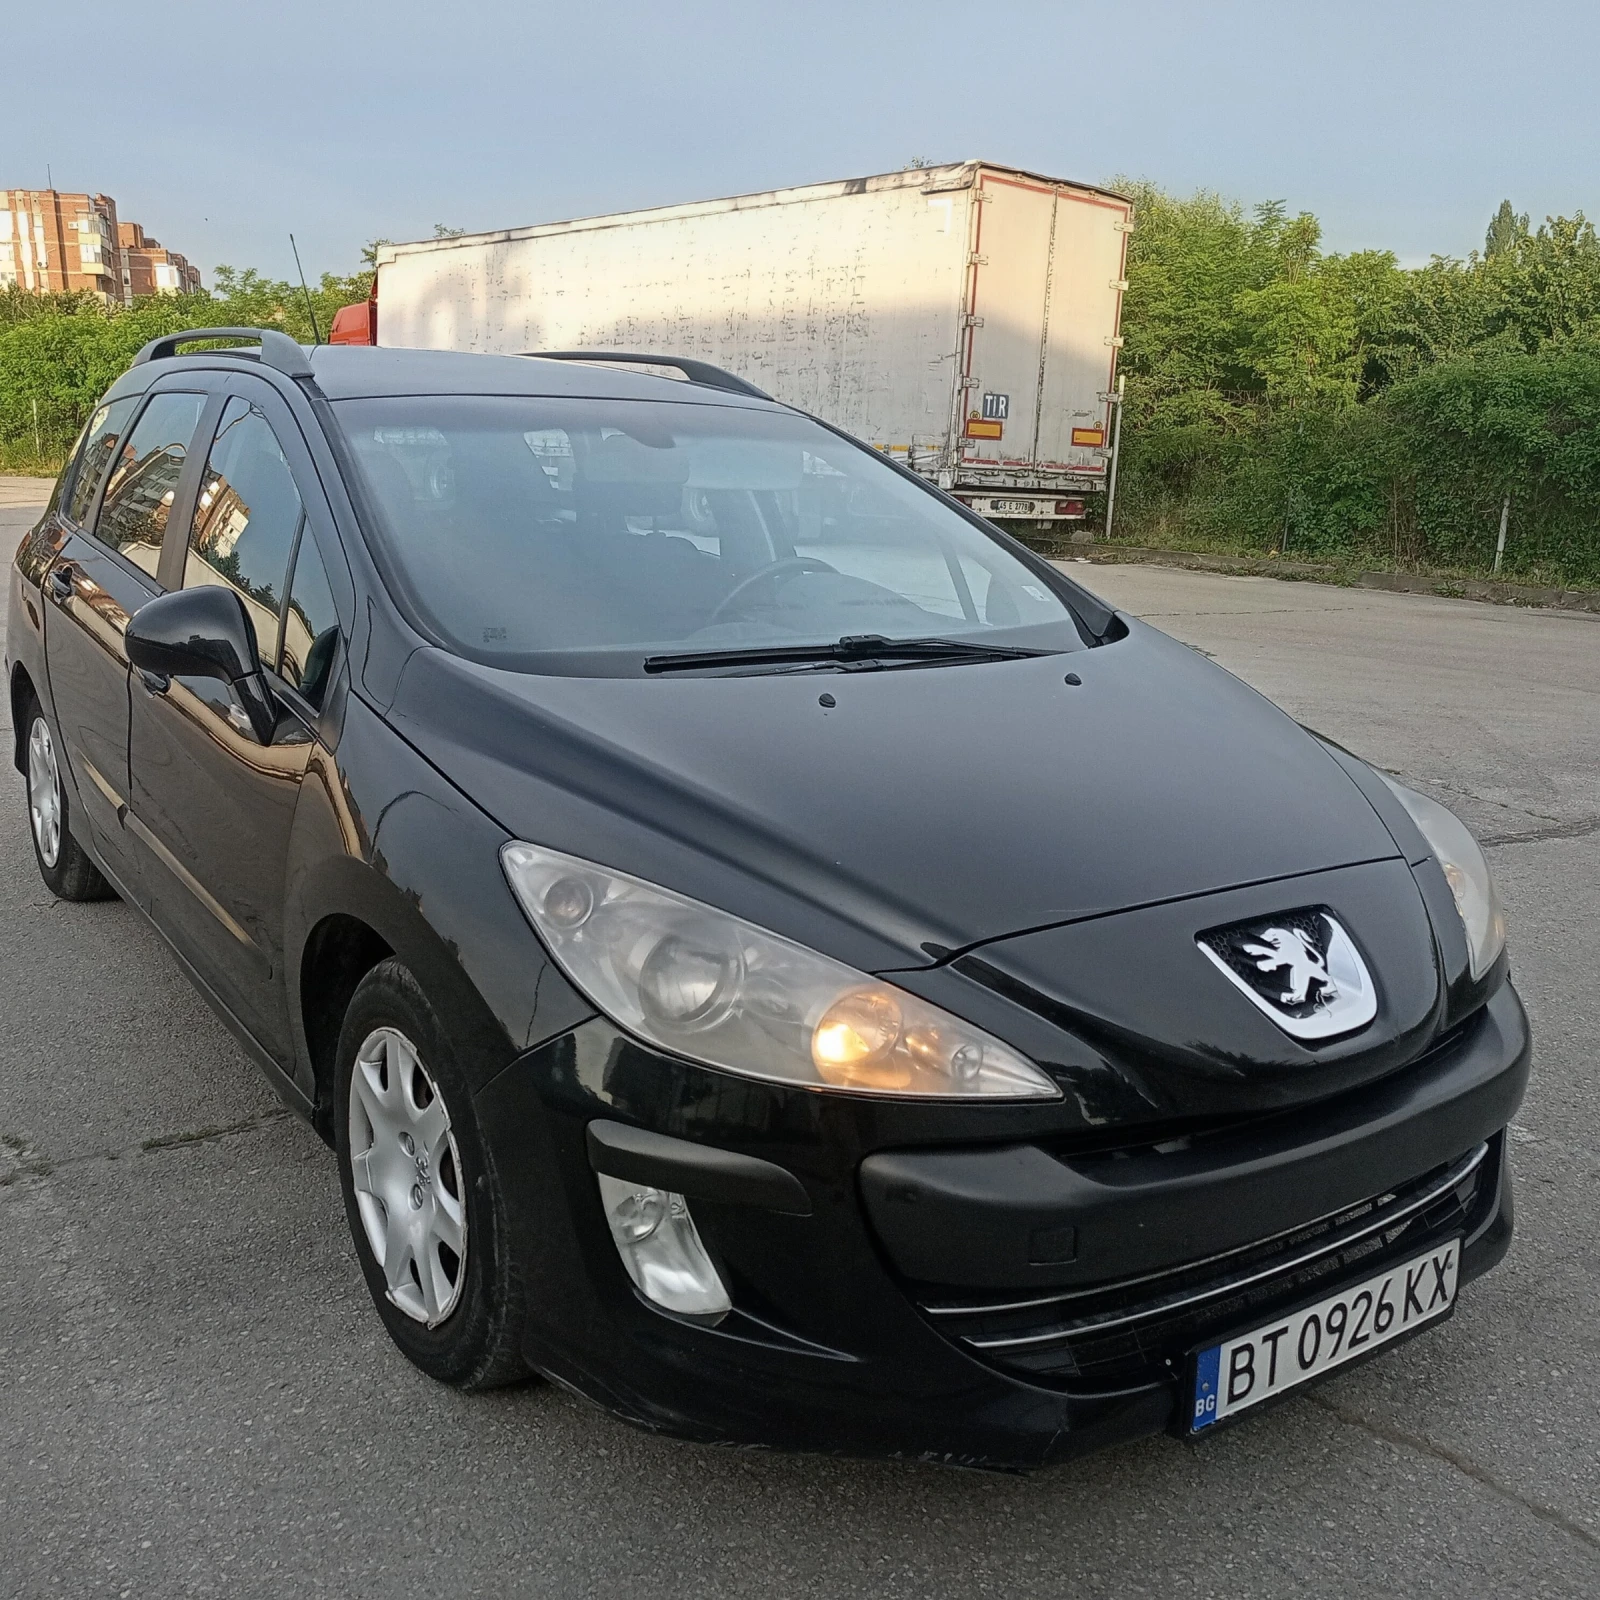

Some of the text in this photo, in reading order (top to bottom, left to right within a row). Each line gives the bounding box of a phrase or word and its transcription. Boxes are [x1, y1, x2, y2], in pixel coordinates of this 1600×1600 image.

[985, 395, 1007, 418] TIR
[1226, 1248, 1454, 1406] BT 0926 KX
[1195, 1394, 1216, 1418] BG
